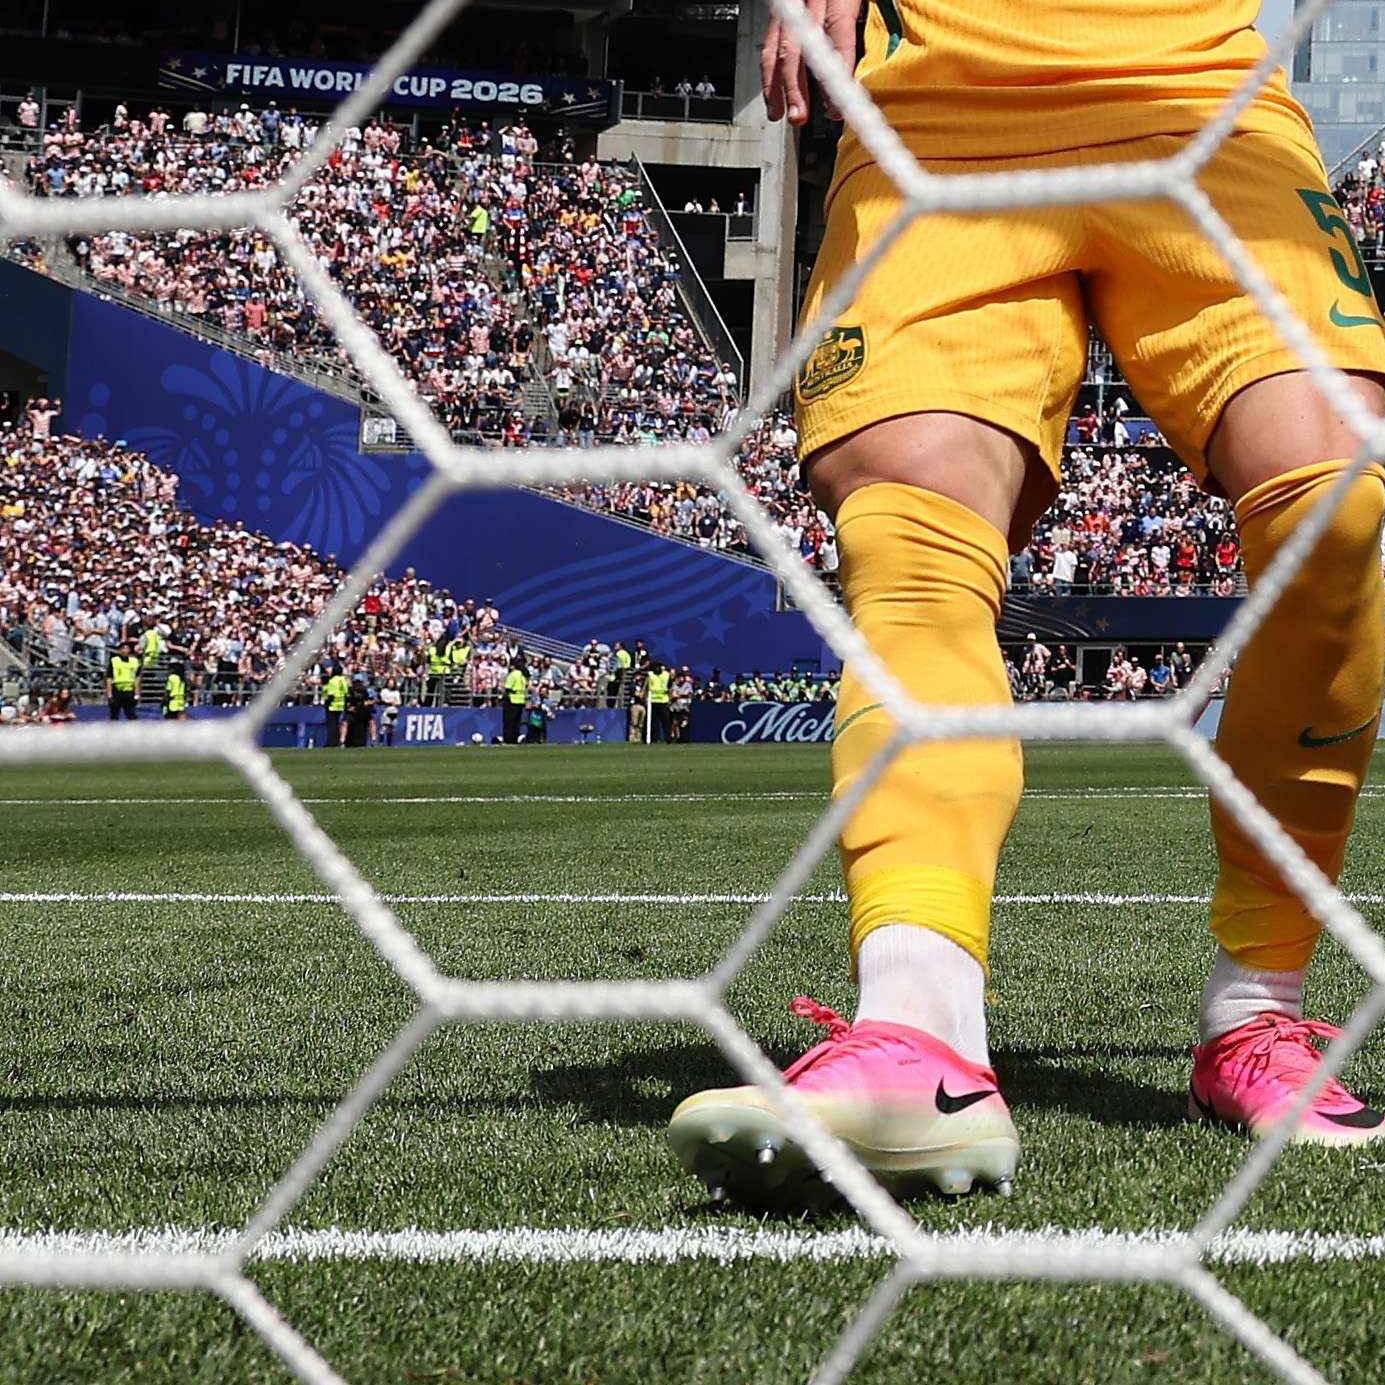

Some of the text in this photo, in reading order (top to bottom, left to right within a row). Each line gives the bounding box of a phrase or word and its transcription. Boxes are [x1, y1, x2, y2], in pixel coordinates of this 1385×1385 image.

[226, 63, 544, 105] FIFA WORL CUP 2026
[1295, 188, 1372, 298] 5
[405, 714, 445, 741] FIFA
[721, 701, 836, 745] Mich
